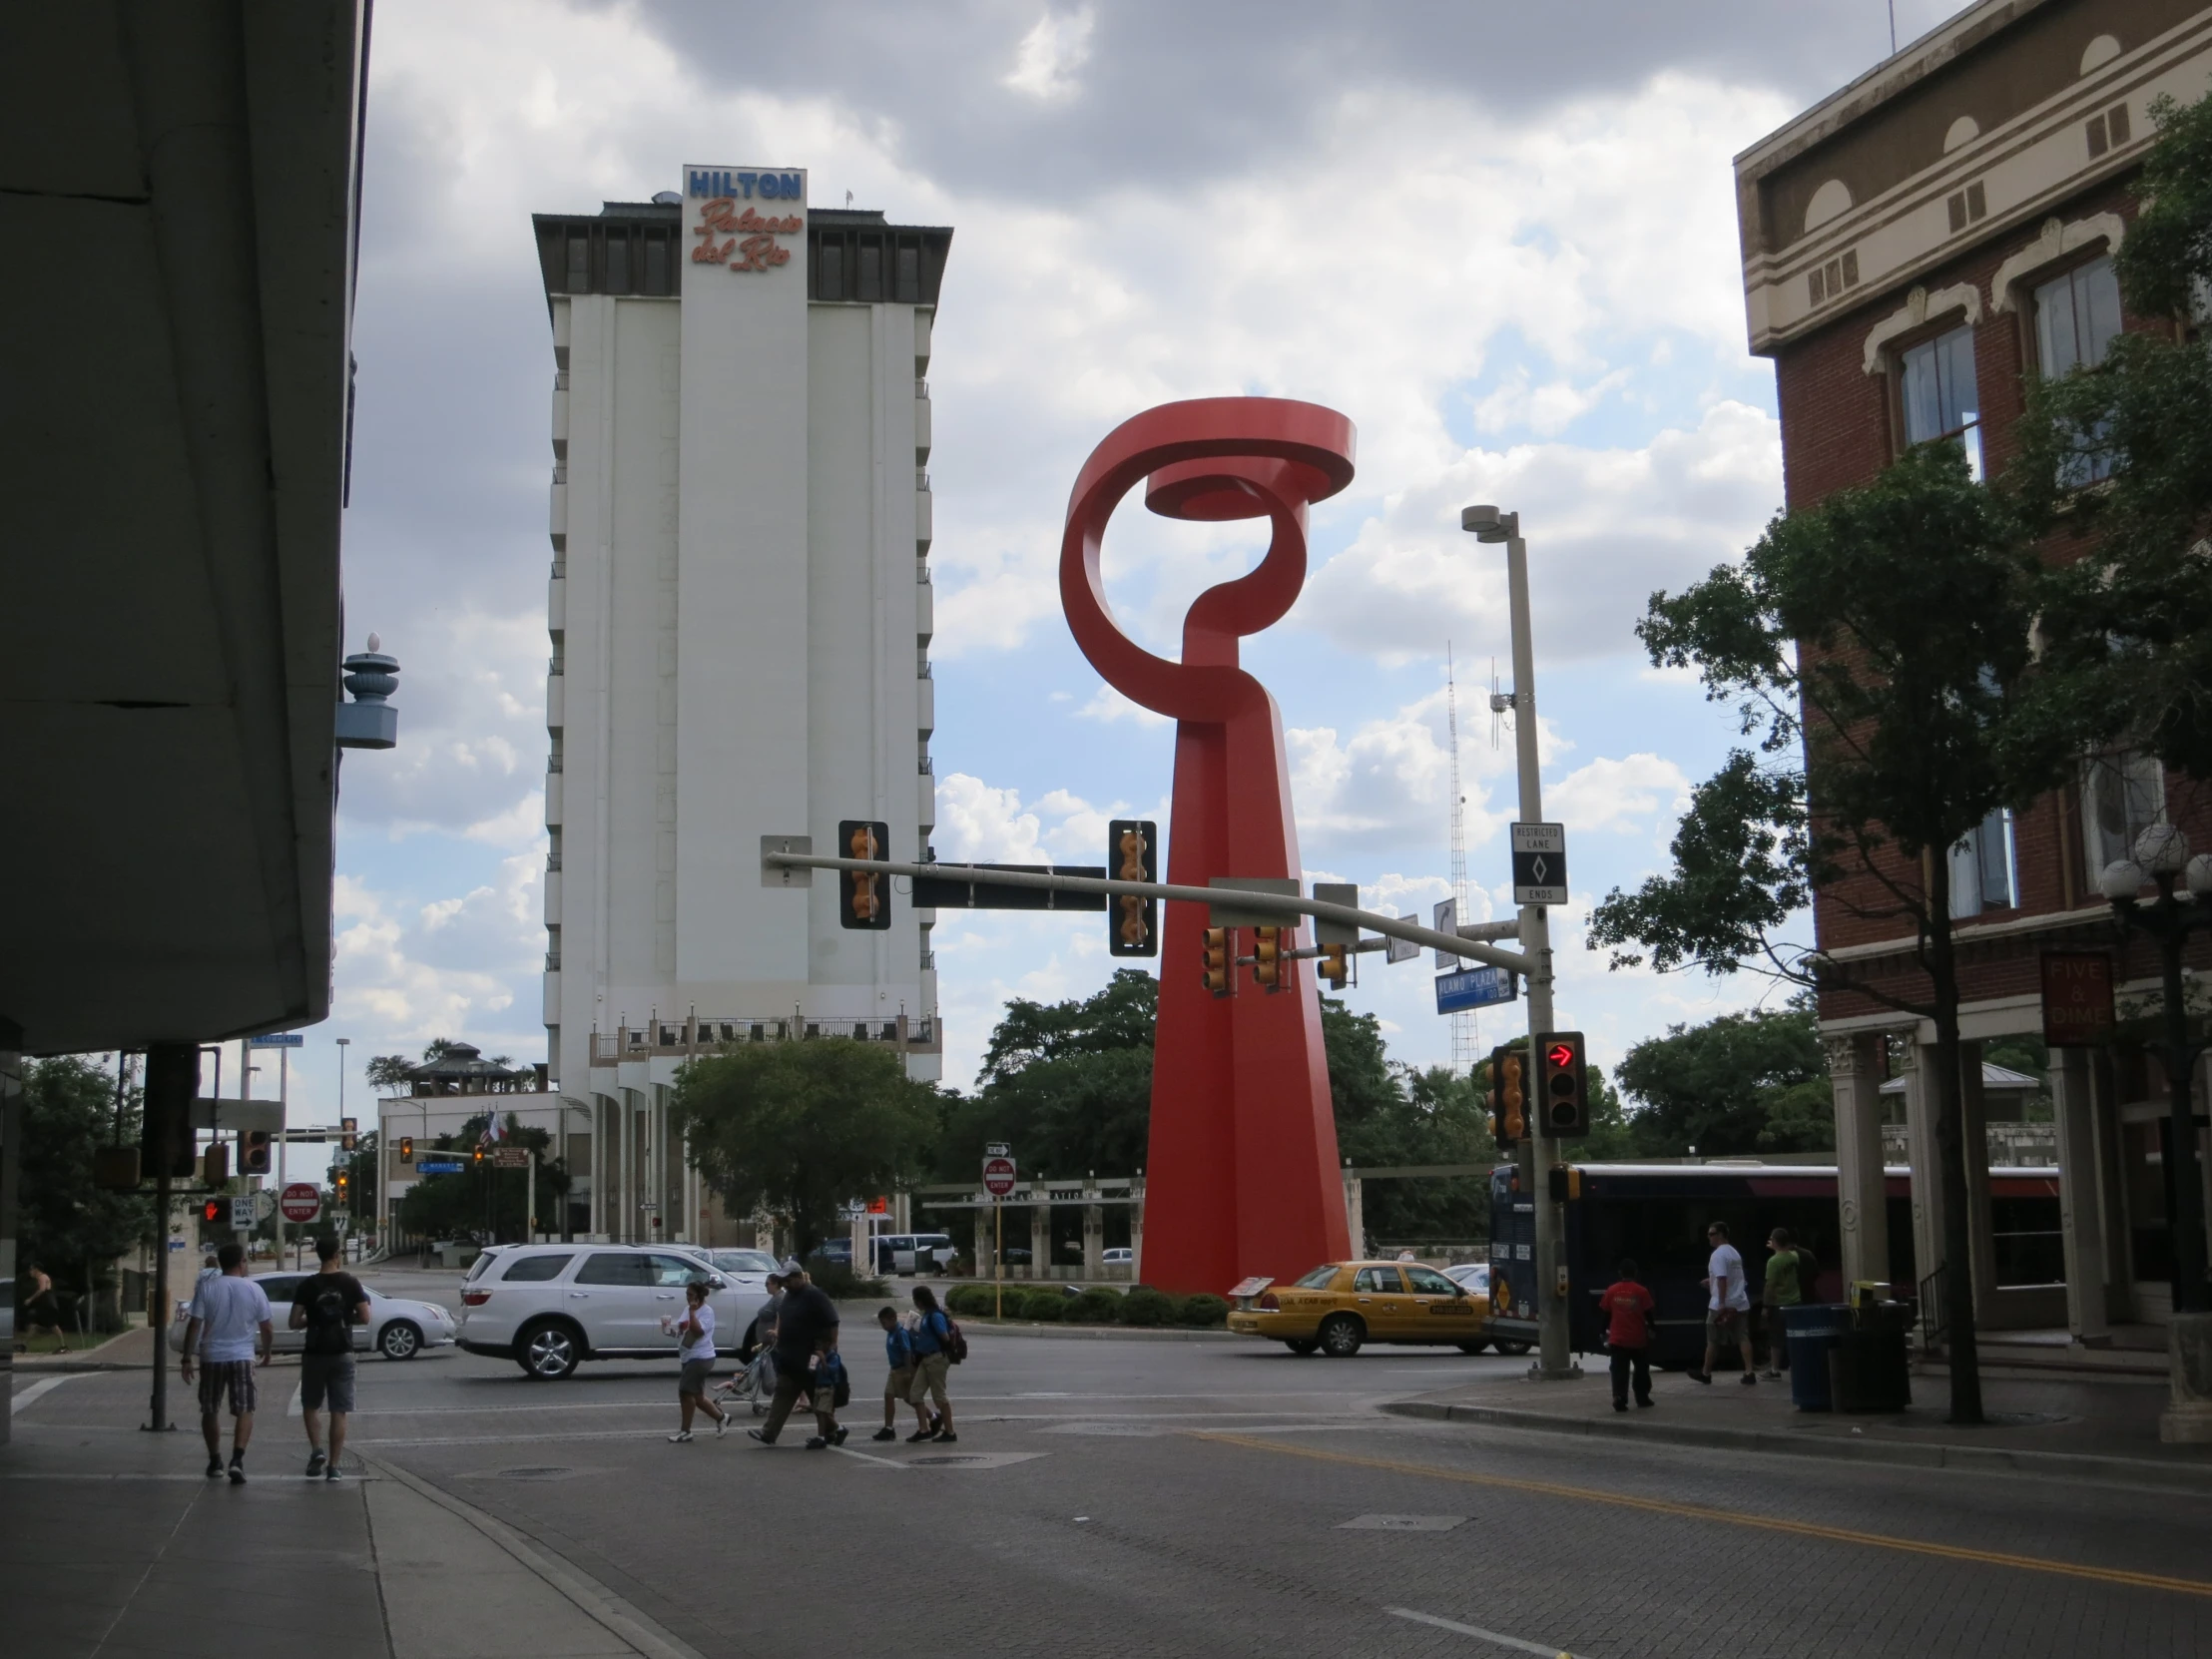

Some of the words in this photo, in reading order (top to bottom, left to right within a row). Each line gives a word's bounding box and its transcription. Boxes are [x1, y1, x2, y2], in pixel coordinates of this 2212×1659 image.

[690, 171, 802, 200] HILTON
[694, 197, 804, 235] Palacio
[692, 233, 736, 264] del
[730, 235, 791, 272] Rio
[1516, 828, 1558, 837] RESTRICTED
[1526, 839, 1550, 849] LANE
[1529, 889, 1553, 899] ENDS
[2050, 961, 2102, 979] FIVE
[1438, 977, 1465, 995] ALAMO
[1470, 969, 1497, 988] PLAZA
[2071, 984, 2086, 1003] &
[2052, 1006, 2108, 1024] DIME
